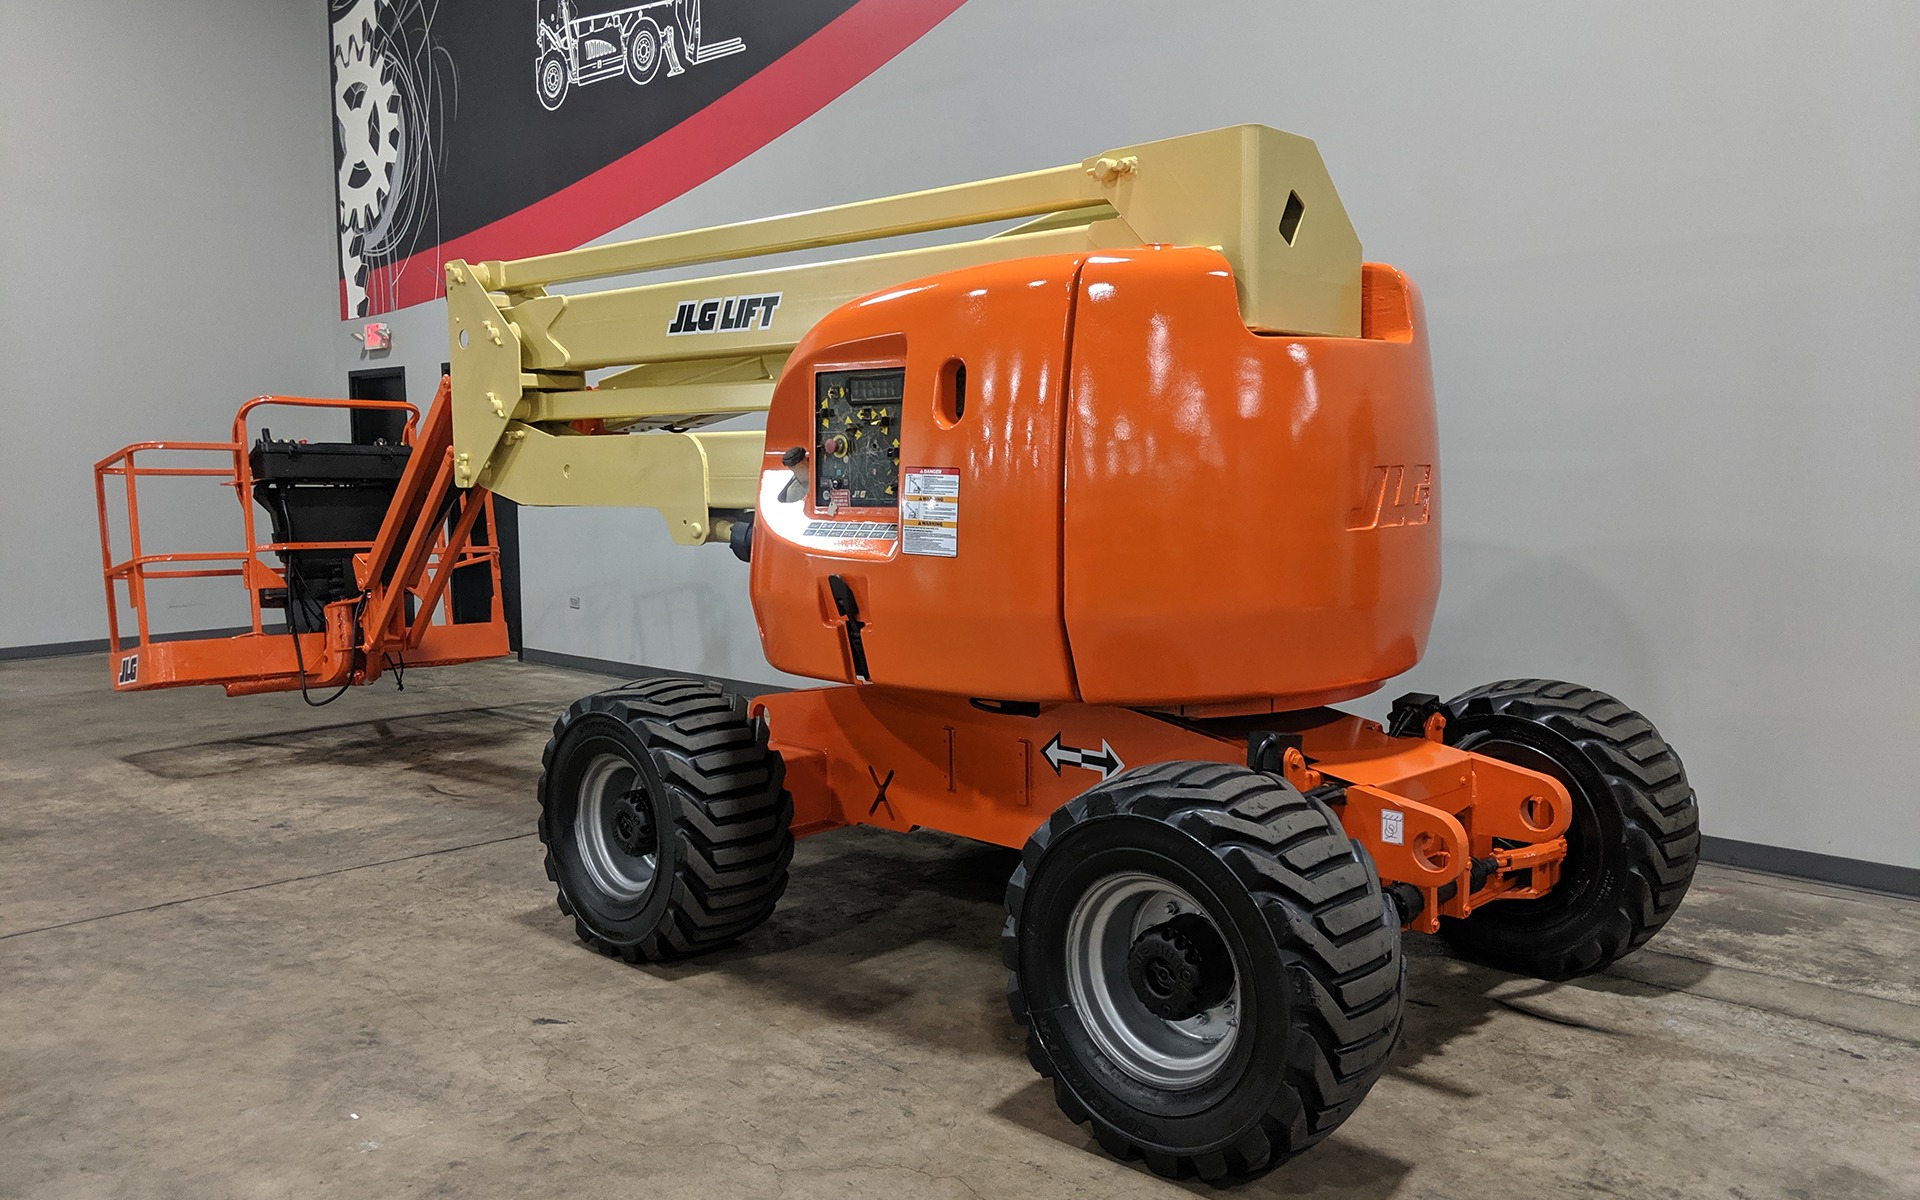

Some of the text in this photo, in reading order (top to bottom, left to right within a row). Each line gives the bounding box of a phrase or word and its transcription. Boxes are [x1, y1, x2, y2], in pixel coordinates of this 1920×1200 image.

[667, 293, 782, 335] JLG LIFT
[1345, 464, 1431, 531] JLG
[118, 655, 138, 684] JLG
